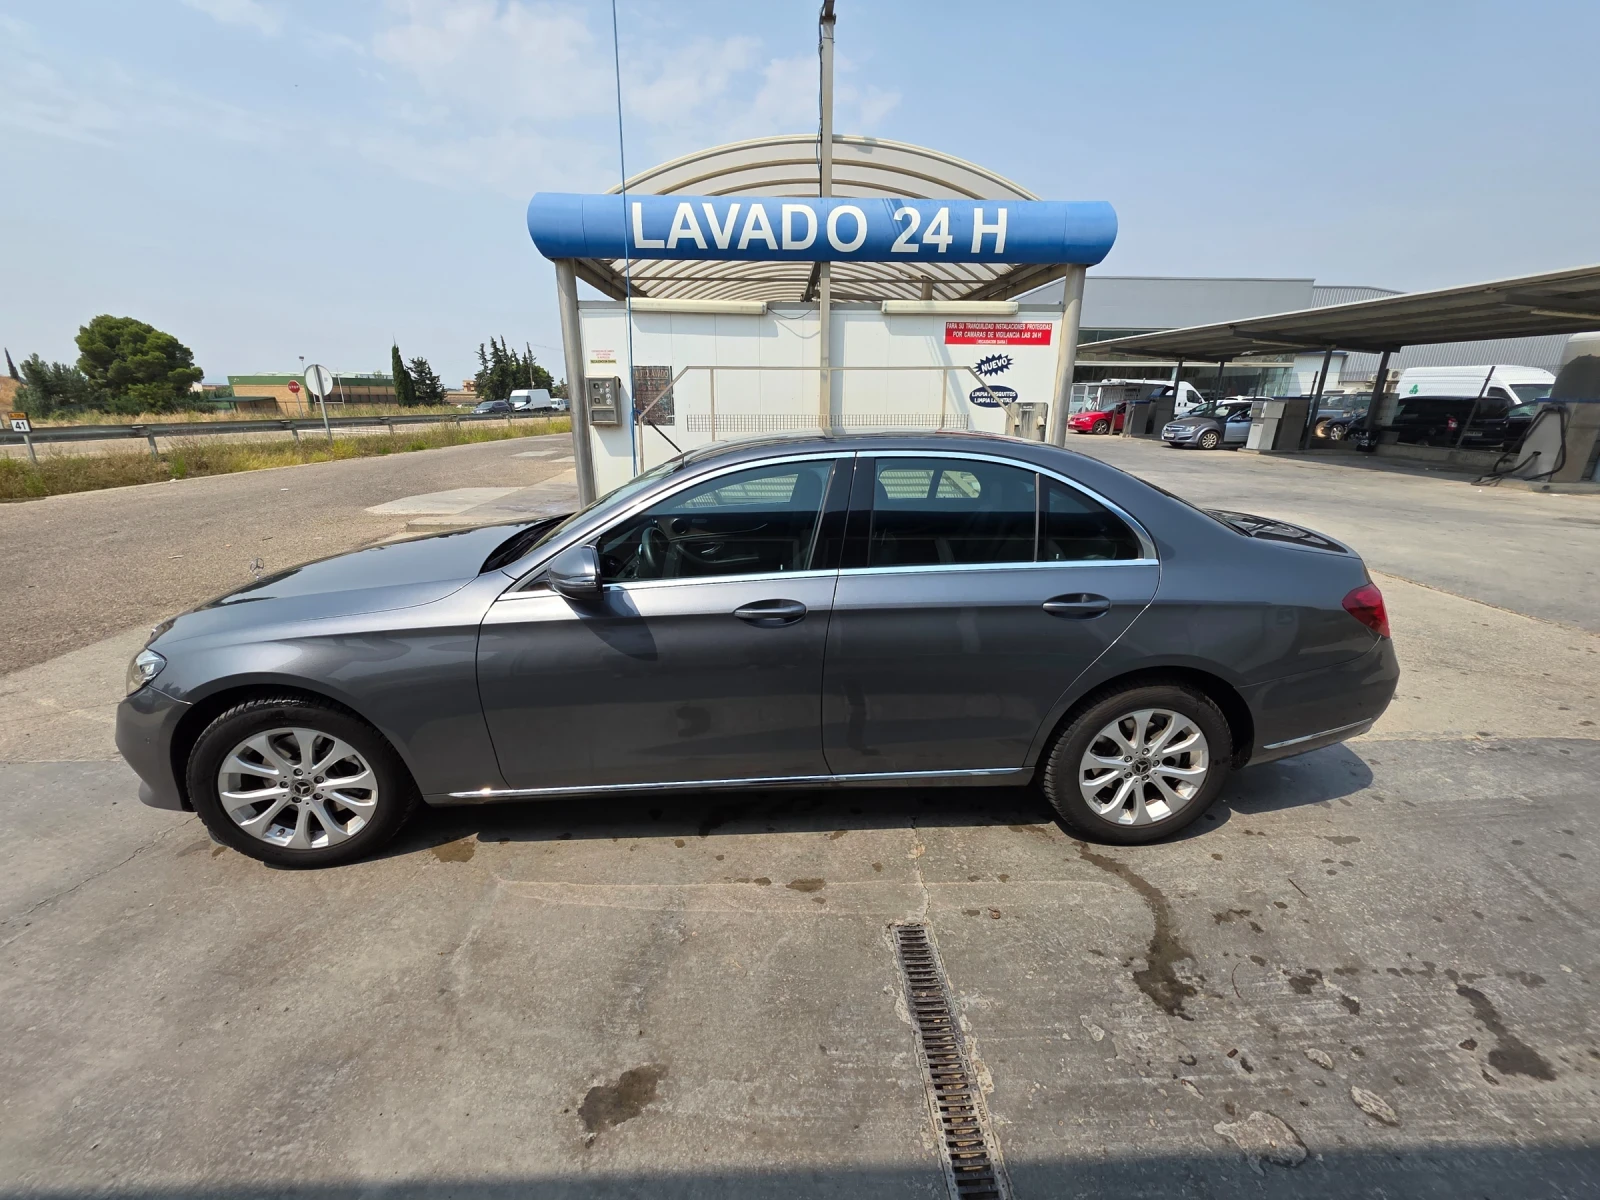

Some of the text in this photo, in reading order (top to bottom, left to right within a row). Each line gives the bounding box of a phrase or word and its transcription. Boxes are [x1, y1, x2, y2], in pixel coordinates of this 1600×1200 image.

[631, 202, 1008, 254] LAVADO 24 H
[1026, 323, 1052, 331] PROTEGIDAS
[996, 331, 1020, 339] VIGILANCIA
[1021, 331, 1031, 339] LAS
[981, 357, 1008, 372] NUEVO
[15, 421, 27, 430] 41
